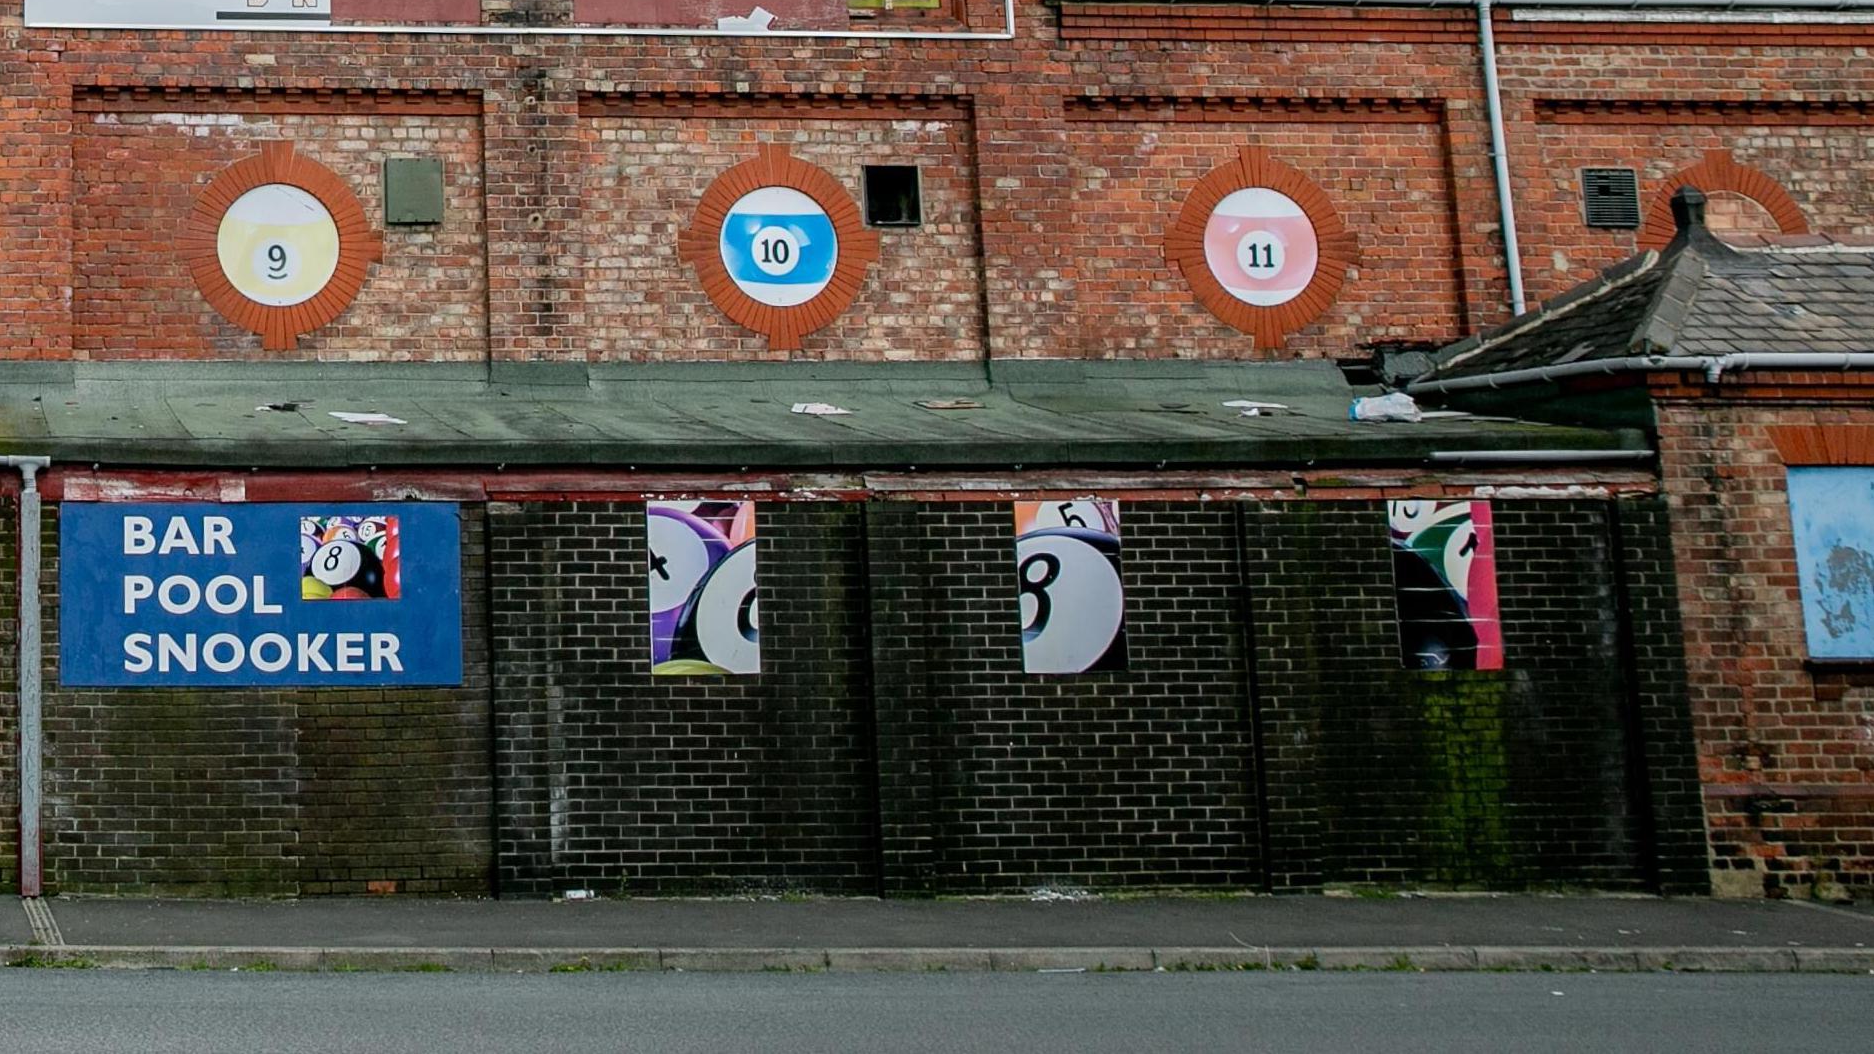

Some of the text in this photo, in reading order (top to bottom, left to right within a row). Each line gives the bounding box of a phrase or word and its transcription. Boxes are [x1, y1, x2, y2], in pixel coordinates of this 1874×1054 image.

[268, 244, 287, 272] 9
[761, 238, 789, 264] 10
[1248, 243, 1275, 267] 11
[123, 515, 237, 555] BAR
[323, 545, 343, 571] 8
[124, 574, 283, 615] POOL
[123, 632, 404, 674] SNOOKER
